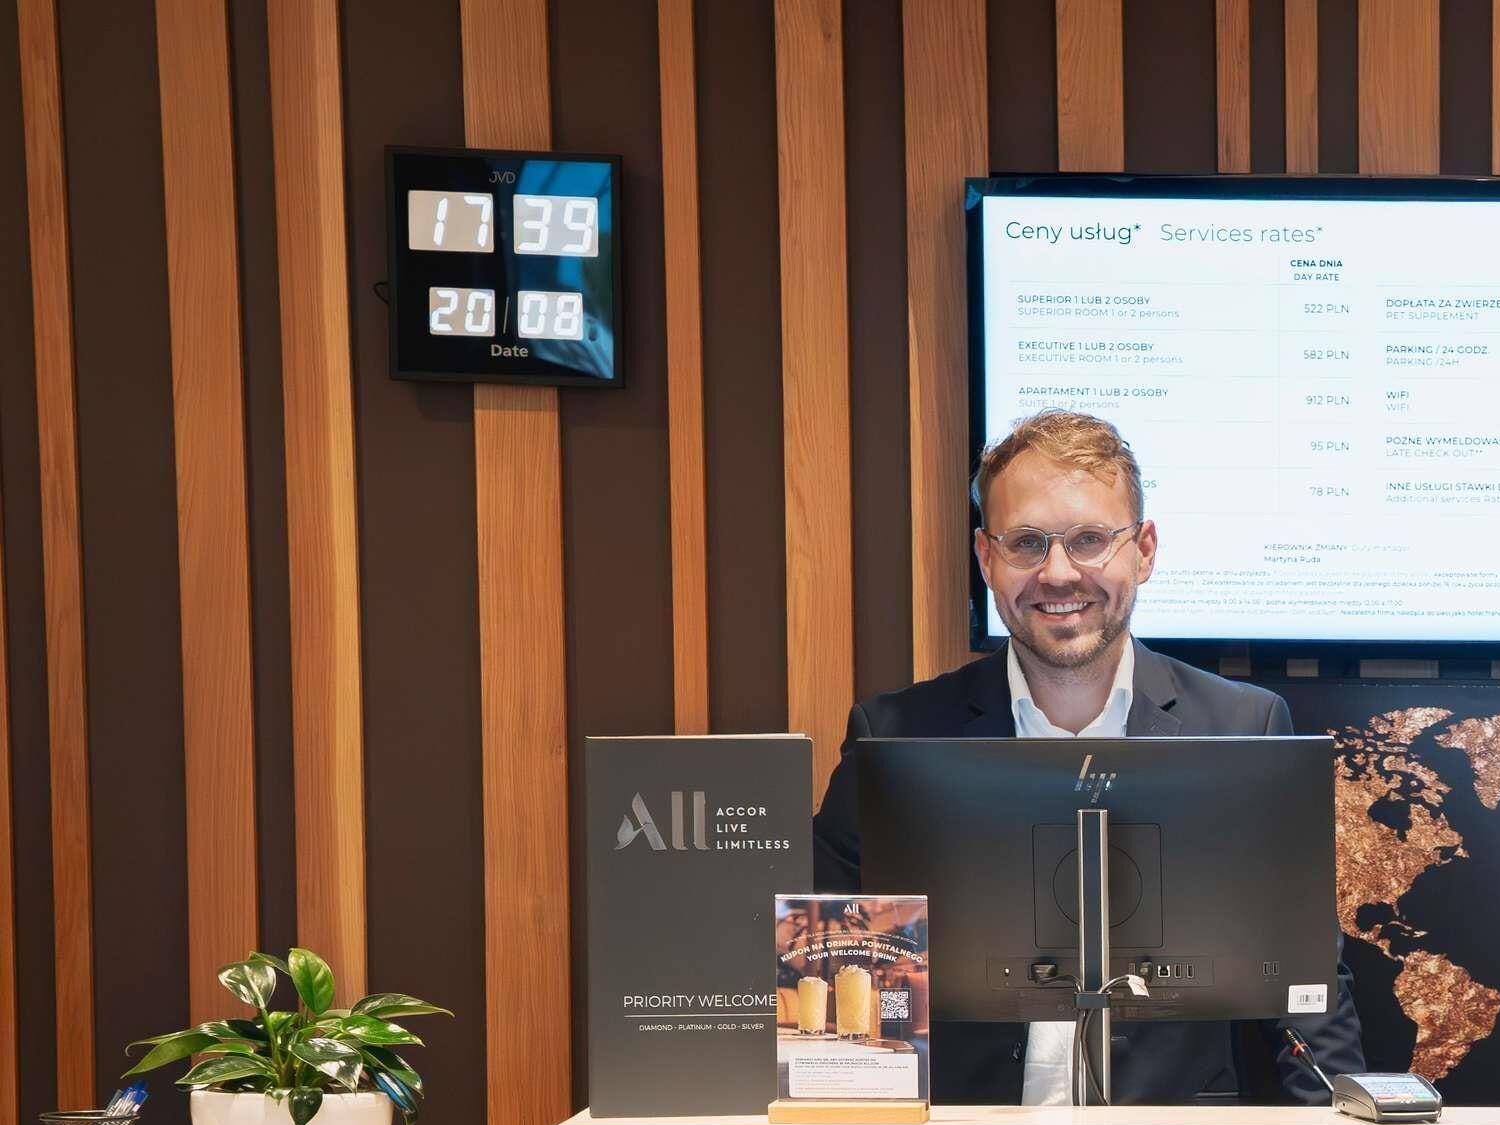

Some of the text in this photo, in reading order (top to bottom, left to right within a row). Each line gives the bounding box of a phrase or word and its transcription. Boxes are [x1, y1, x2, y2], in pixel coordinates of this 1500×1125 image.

[488, 171, 516, 185] JVD
[433, 196, 595, 253] 17 39
[1005, 221, 1063, 244] Ceny
[1160, 223, 1253, 243] Services
[1290, 260, 1343, 268] CENA DNIA
[1294, 273, 1340, 282] DAY RATE
[1018, 295, 1072, 304] SUPERIOR
[1081, 296, 1102, 305] LUB
[1104, 296, 1111, 305] 2
[1113, 296, 1151, 306] OSOBY
[1386, 298, 1436, 309] DOPŁATA
[1438, 299, 1452, 309] ZA
[430, 290, 493, 333] 20
[520, 294, 581, 336] 08
[1018, 308, 1072, 317] SUPERIOR
[1074, 309, 1109, 318] ROOM
[1130, 310, 1137, 318] 2
[1139, 310, 1180, 320] persons
[1304, 304, 1350, 314] 522 PLN
[1386, 312, 1480, 321] PET SUPPLEMENT
[490, 344, 529, 358] Date
[1018, 341, 1076, 351] EXECUTIVE
[1085, 342, 1106, 351] LUB
[1108, 342, 1116, 351] 2
[1117, 342, 1154, 352] OSOBY
[1386, 345, 1433, 355] PARKING
[1442, 346, 1455, 355] 24
[1018, 354, 1077, 364] EXECUTIVE
[1079, 354, 1112, 364] ROOM
[1134, 356, 1141, 364] 2
[1143, 356, 1184, 366] persons
[1303, 350, 1350, 361] 582 PLN
[1386, 358, 1433, 367] PARKING
[1018, 387, 1091, 397] APARTAMENT
[1100, 388, 1121, 397] LUB
[1123, 388, 1130, 397] 2
[1132, 388, 1169, 398] OSOBY
[1386, 391, 1410, 400] WIFI
[1018, 399, 1048, 408] SUITE
[1078, 400, 1120, 411] persons
[1305, 396, 1350, 406] 912 PLN
[1310, 441, 1350, 452] 95 PLN
[1386, 449, 1412, 458] LATE
[1414, 449, 1451, 458] CHECK
[1310, 487, 1350, 497] 78 PLN
[1386, 482, 1412, 492] INNE
[1414, 482, 1453, 492] USŁUGI
[1455, 482, 1496, 492] STAWKI
[1073, 754, 1117, 803] hp
[716, 807, 768, 817] ACCOR
[716, 824, 749, 833] LIVE
[716, 840, 791, 850] LIMITLESS
[780, 940, 924, 963] KUPON NA DRINKA POWITALNEGO
[807, 949, 898, 963] YOUR WELCOME DRINK
[624, 994, 778, 1008] PRIORITY WELCOME
[639, 1024, 674, 1032] DIAMOND
